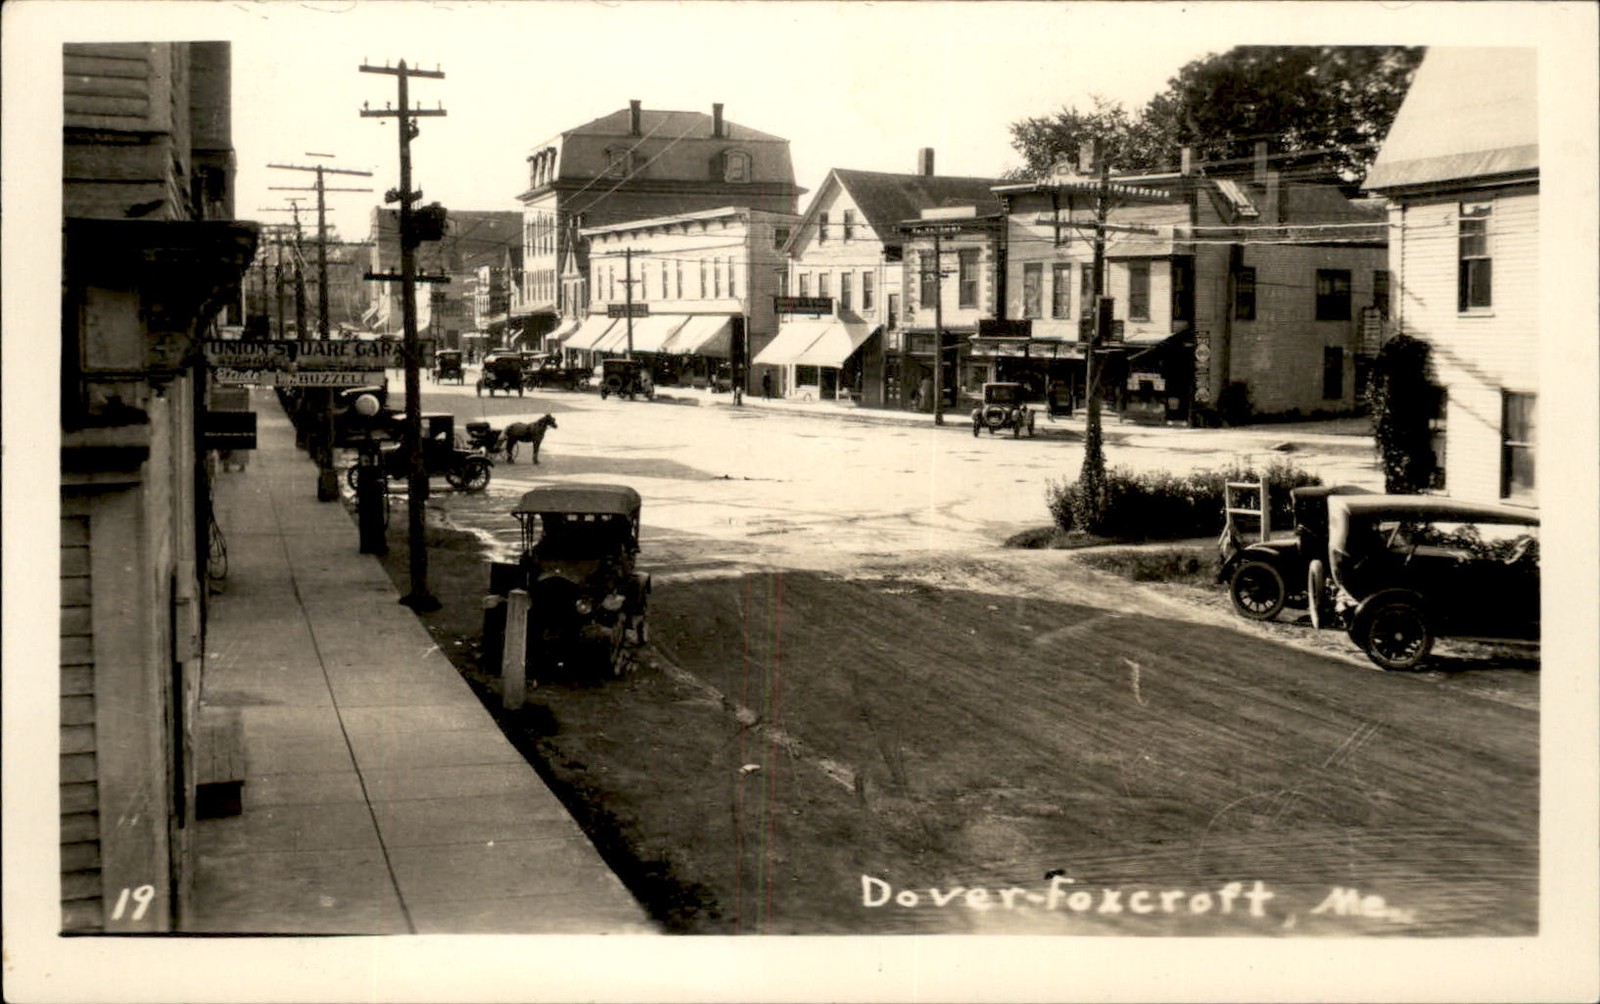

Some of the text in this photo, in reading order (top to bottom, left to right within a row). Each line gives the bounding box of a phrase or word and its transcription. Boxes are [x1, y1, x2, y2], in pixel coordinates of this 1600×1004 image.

[210, 342, 427, 358] UNION SUARE GARAE
